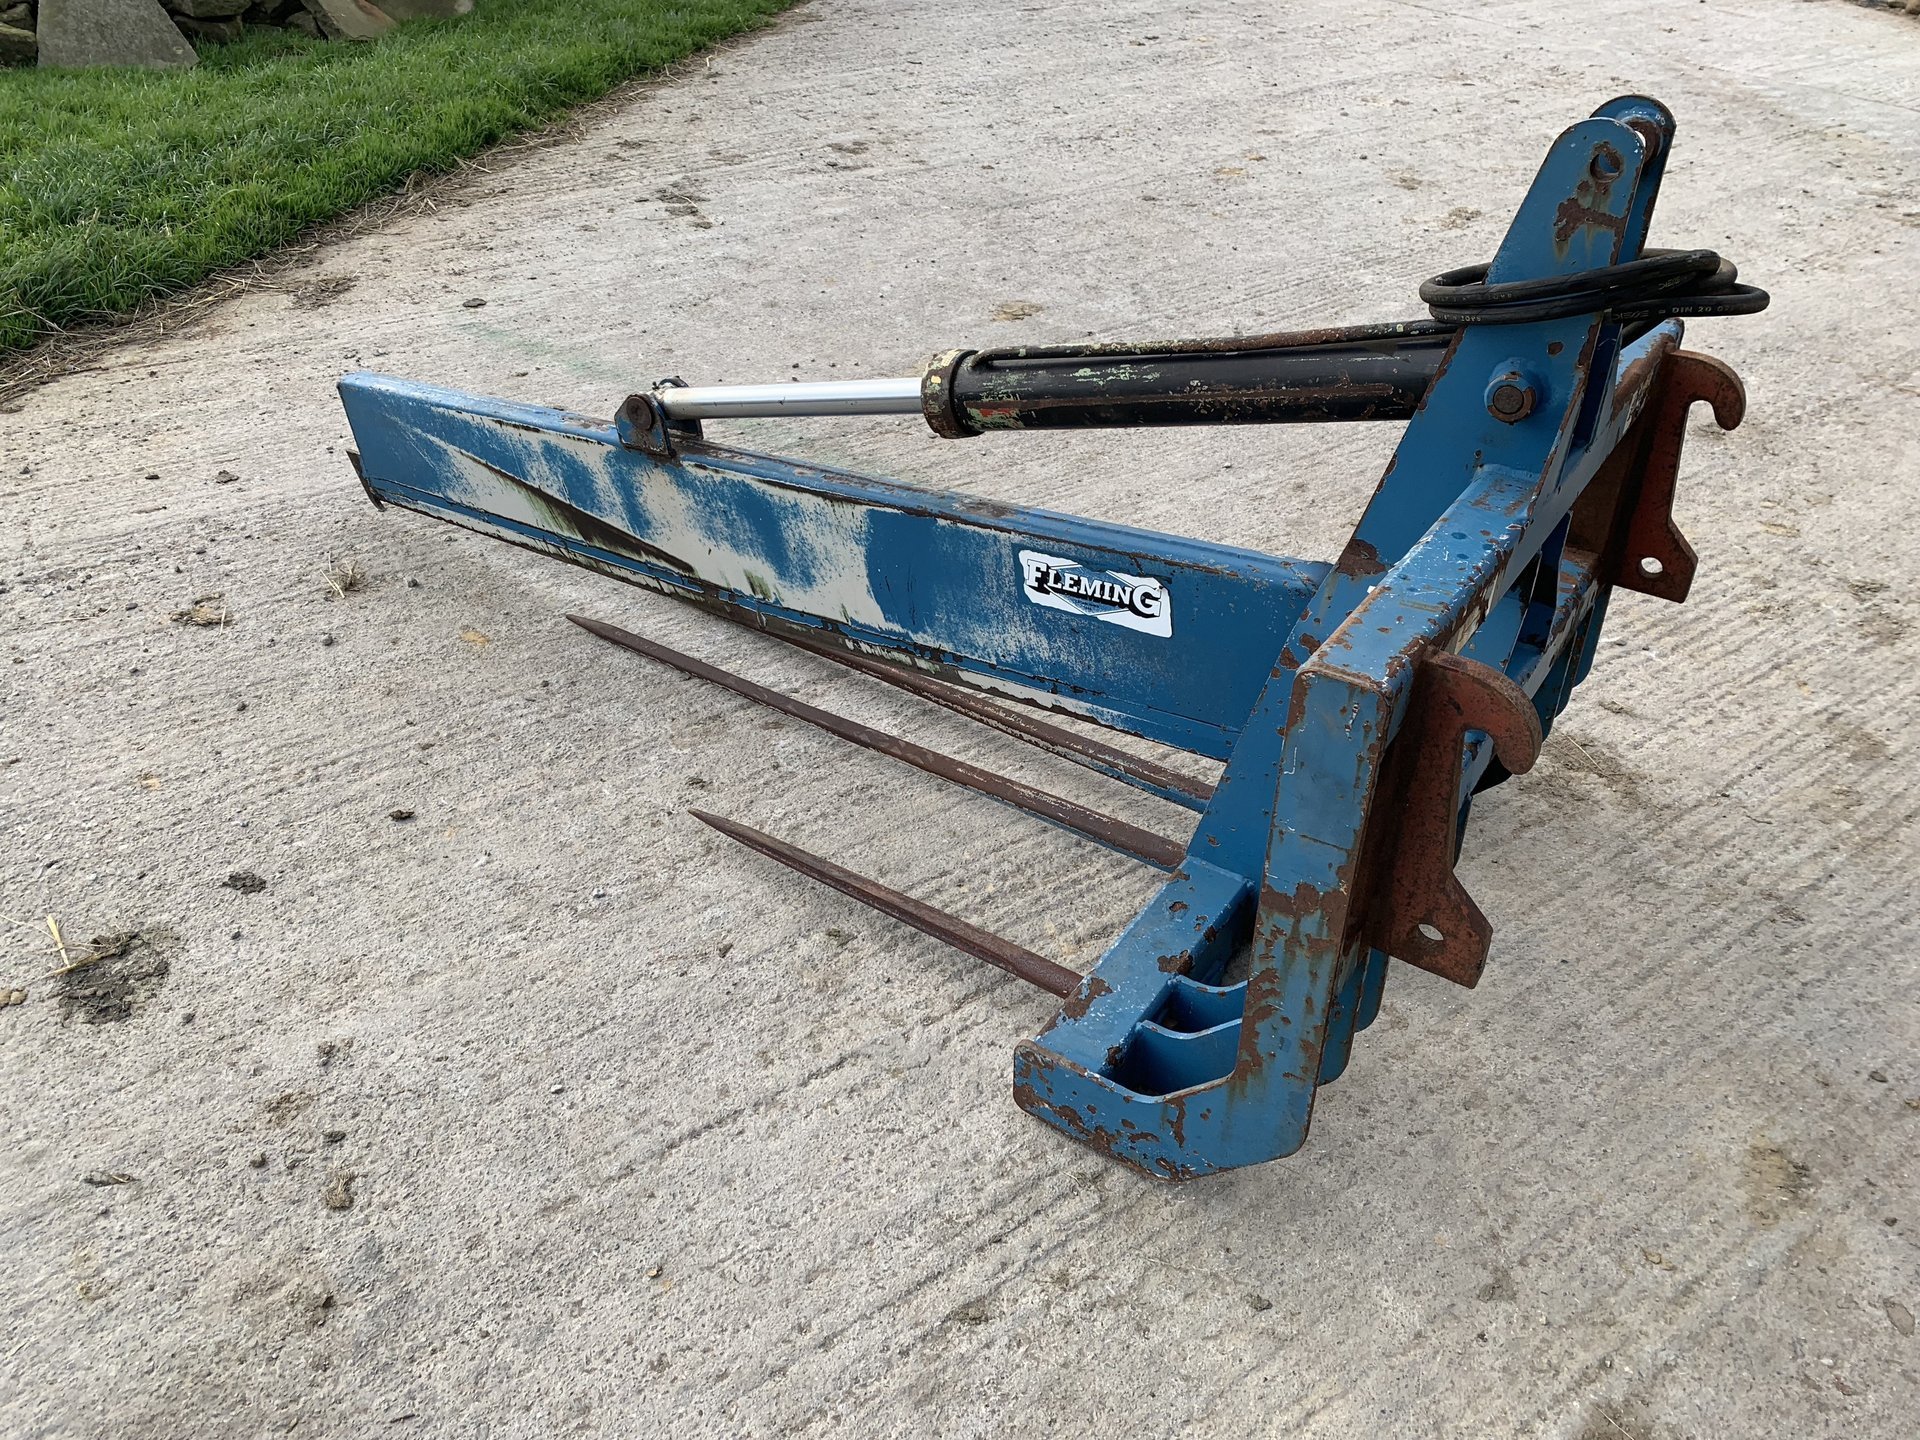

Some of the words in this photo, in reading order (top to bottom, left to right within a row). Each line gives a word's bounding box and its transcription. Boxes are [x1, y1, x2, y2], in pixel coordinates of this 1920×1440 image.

[1672, 306, 1693, 314] DIN
[1697, 305, 1712, 313] 20
[1026, 558, 1162, 618] FLEMING
